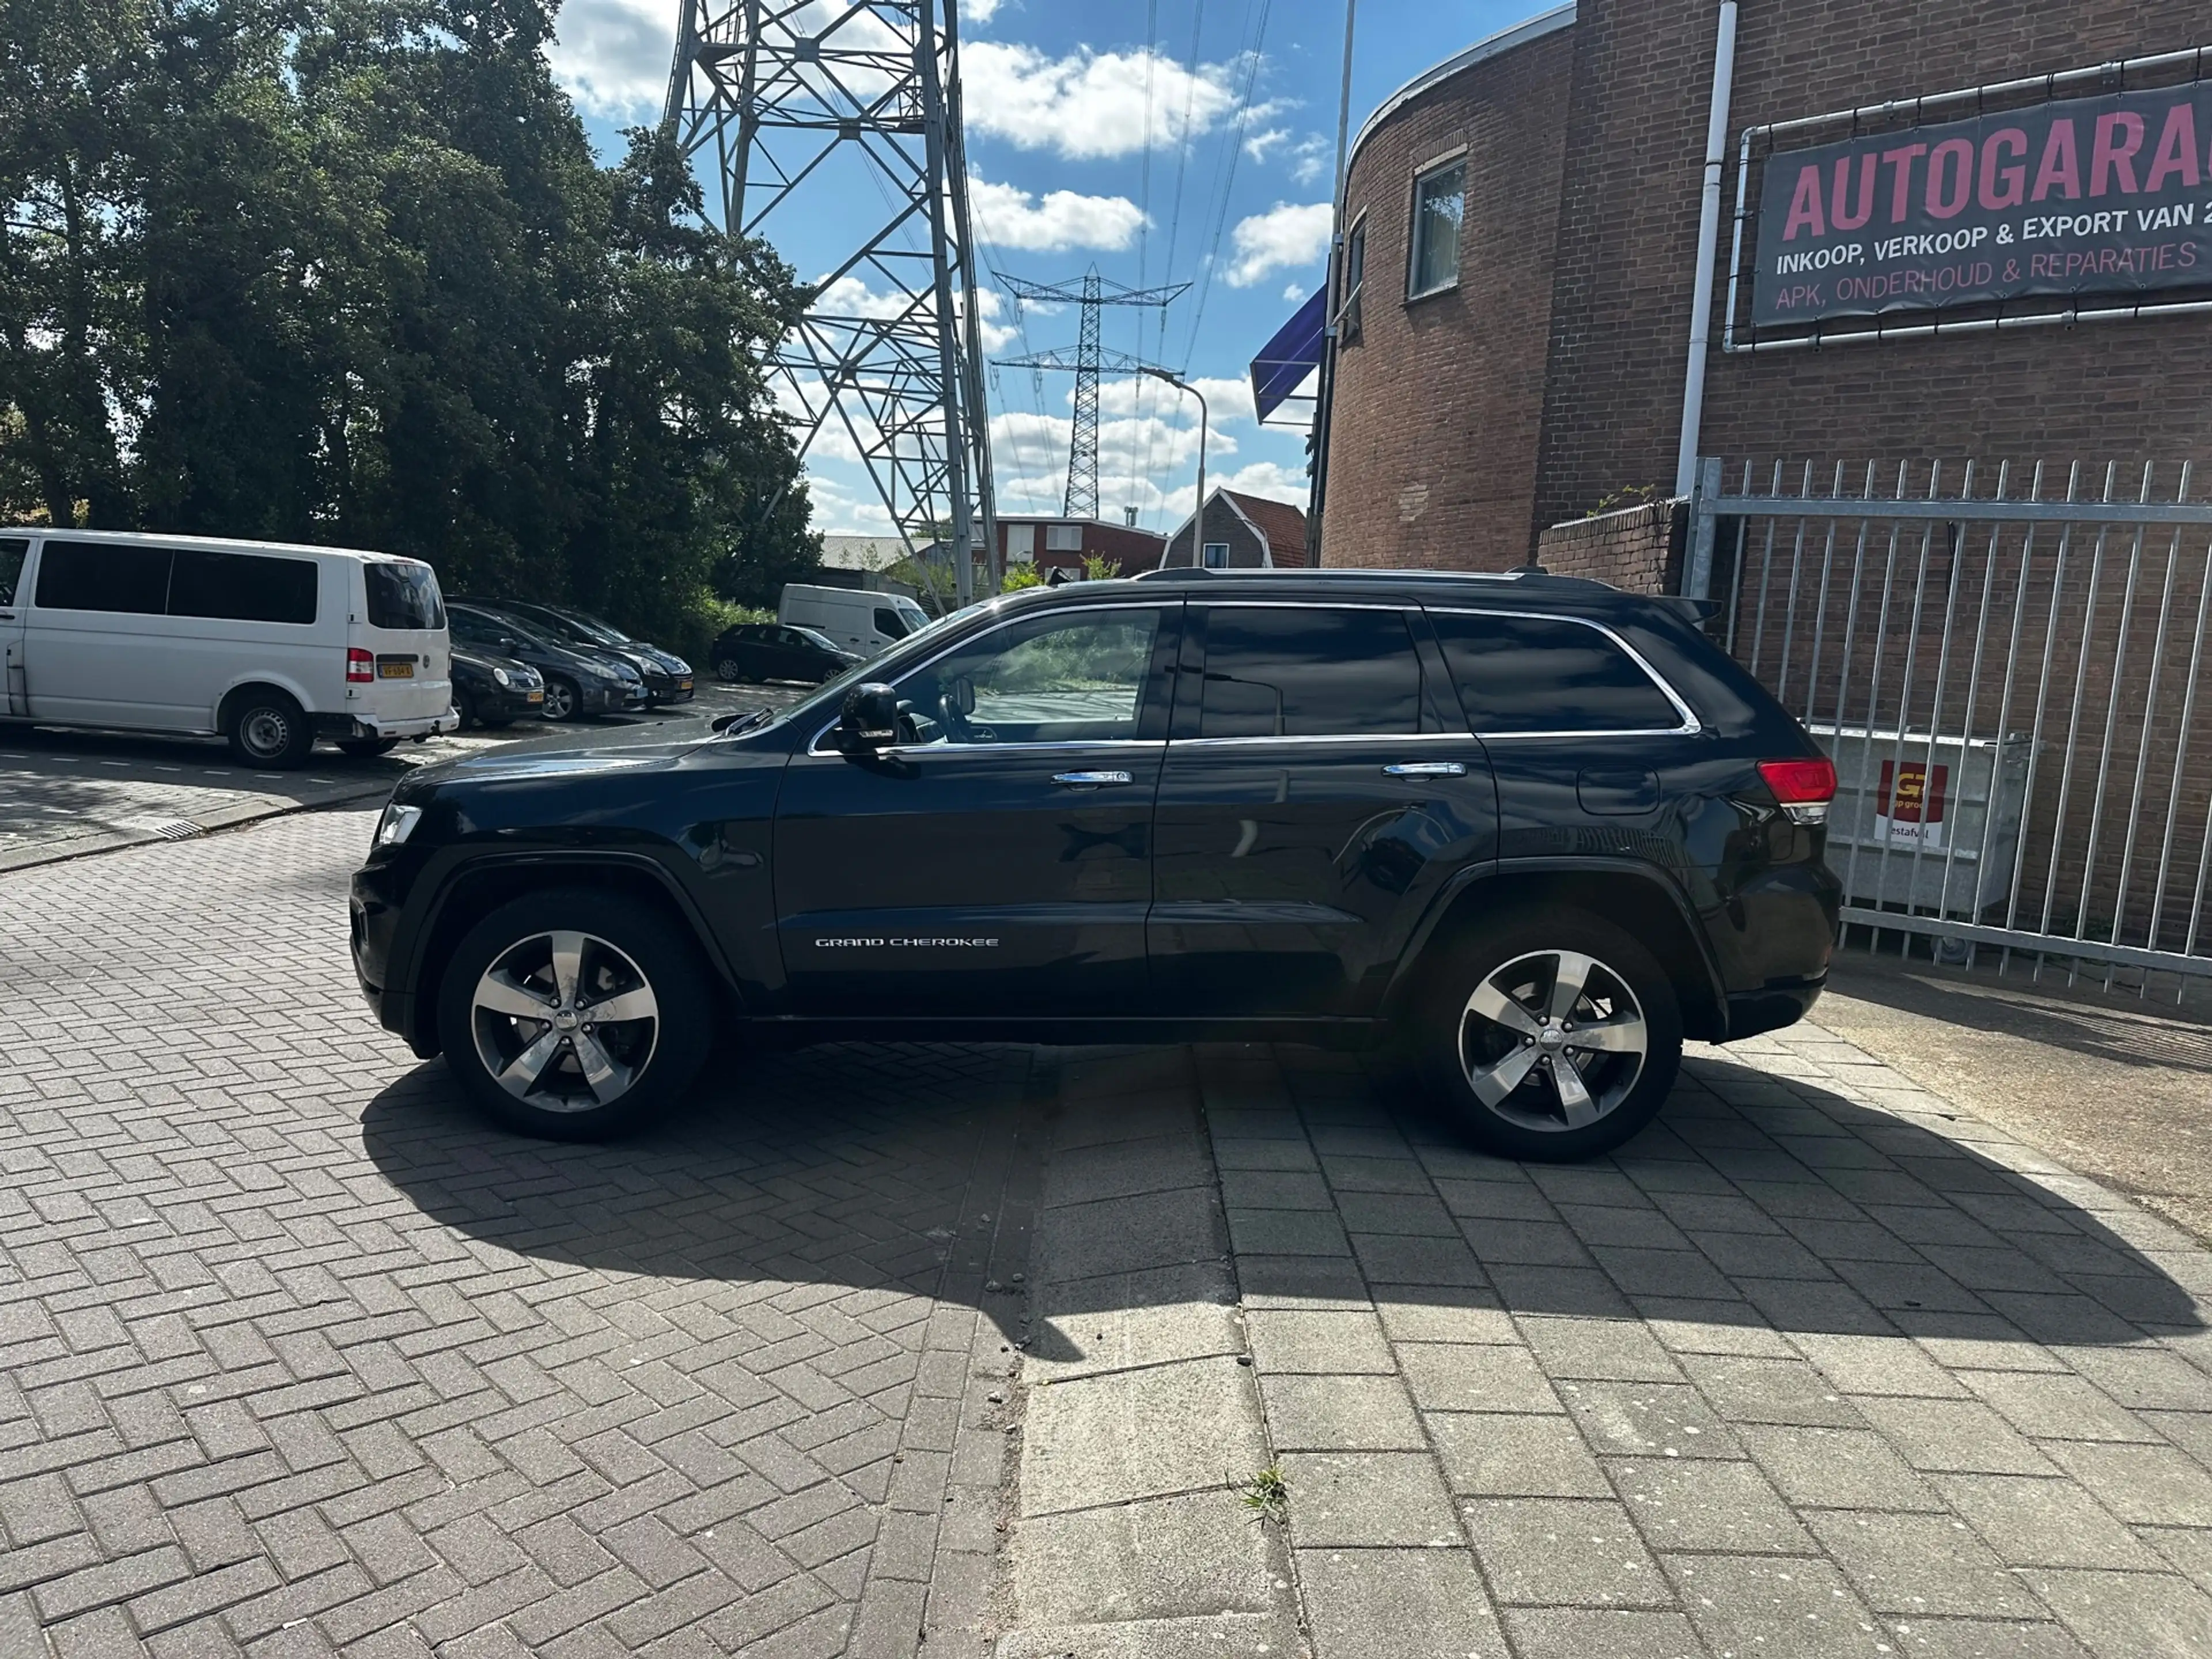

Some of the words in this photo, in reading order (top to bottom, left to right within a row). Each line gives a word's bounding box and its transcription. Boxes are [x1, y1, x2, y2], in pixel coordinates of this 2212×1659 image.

[1782, 103, 2212, 242] AUTOGARA
[1776, 243, 1865, 275] INKOOP,
[1873, 226, 1988, 262] VERKOOP
[1995, 223, 2014, 245] &
[2022, 210, 2129, 240] EXPORT
[2137, 203, 2195, 232] VAN
[1775, 283, 1827, 310] APK,
[1836, 262, 1993, 301] ONDERHOUD
[2002, 258, 2021, 283] &
[2030, 241, 2197, 278] REPARATIES
[815, 938, 885, 947] GRAND
[889, 938, 1000, 947] CHEROKEE
